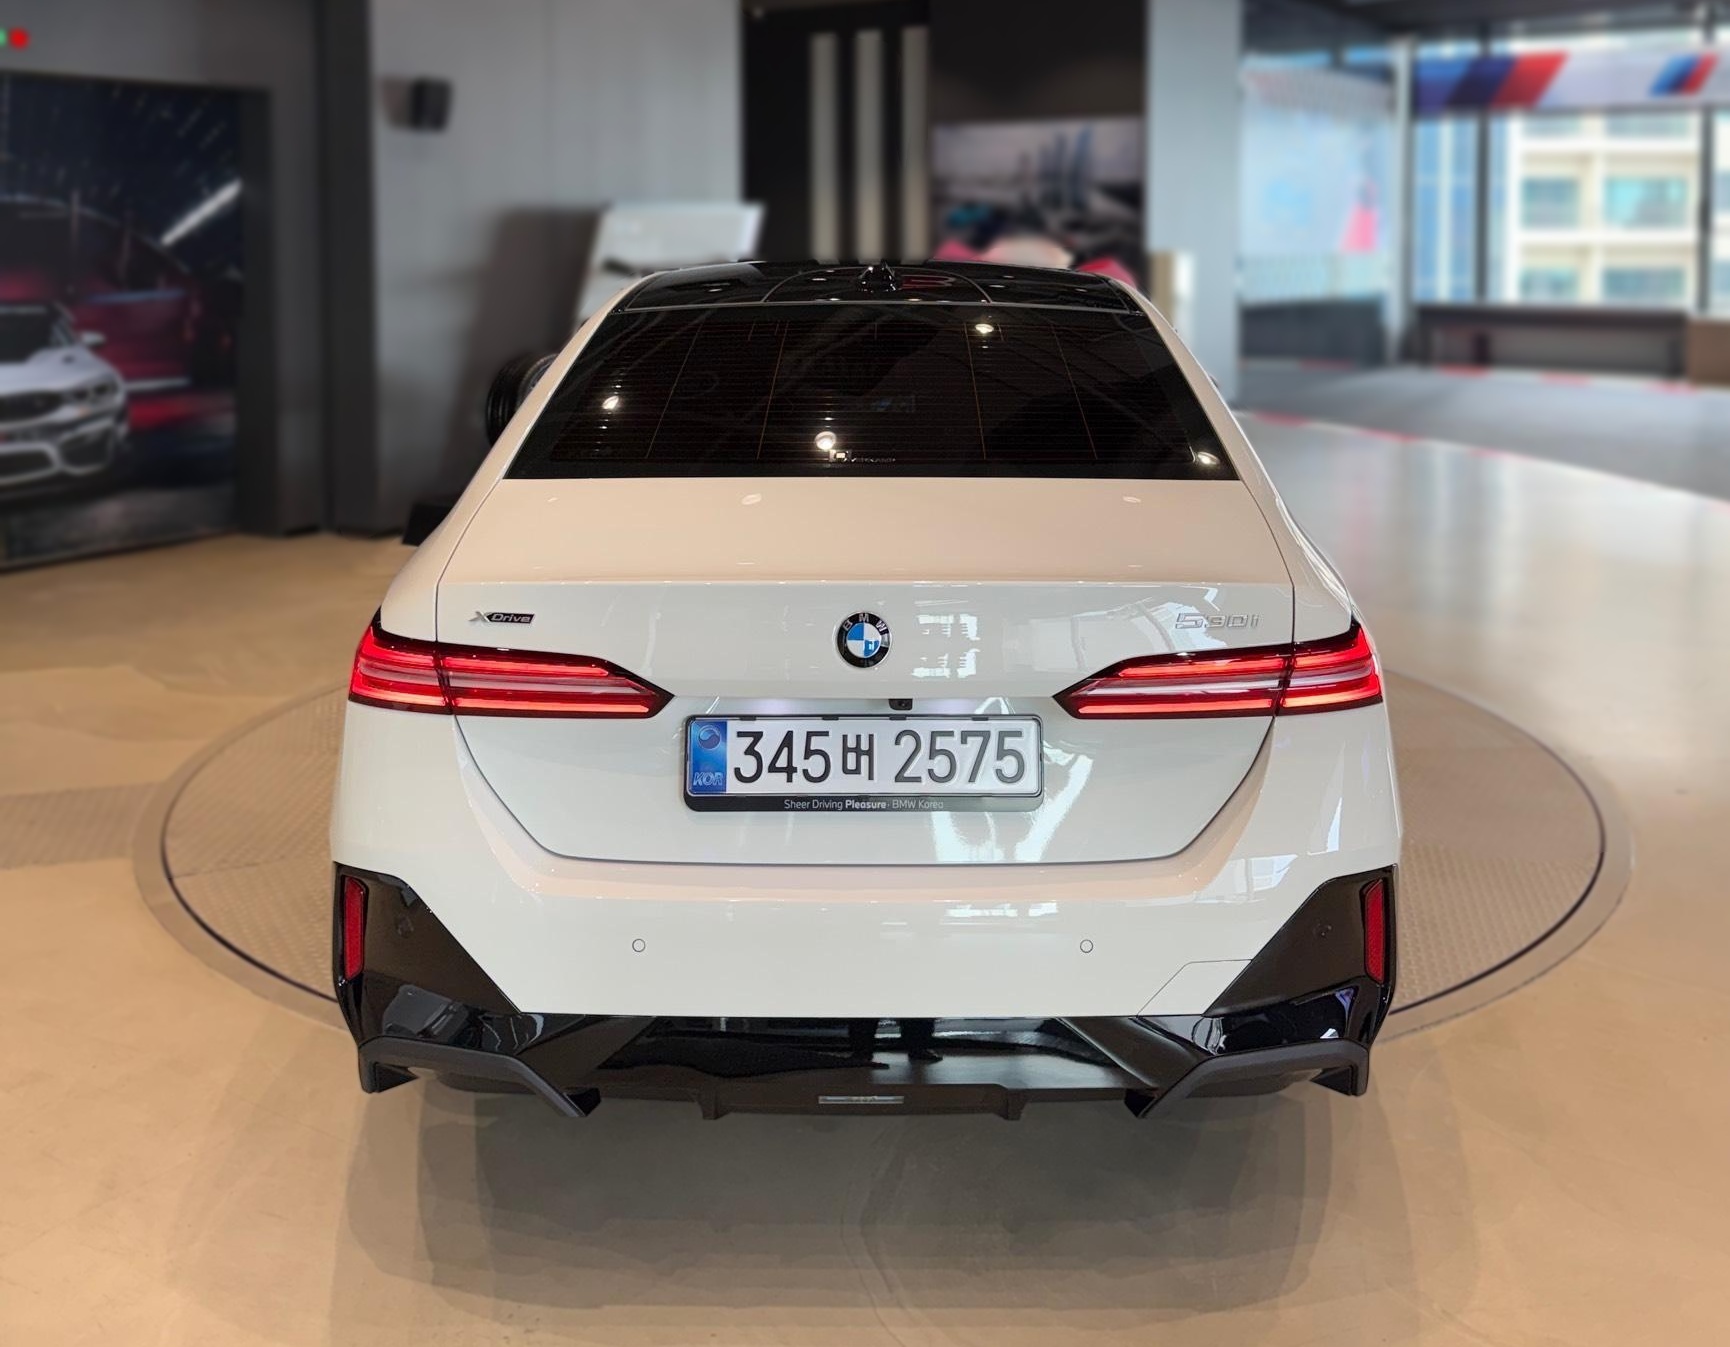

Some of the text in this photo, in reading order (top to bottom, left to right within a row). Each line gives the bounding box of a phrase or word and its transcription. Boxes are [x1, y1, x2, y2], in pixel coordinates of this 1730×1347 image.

[894, 729, 1025, 783] 2575
[693, 771, 723, 786] KOR
[783, 799, 944, 811] Sheer Driving Pleasure BMW Korea
